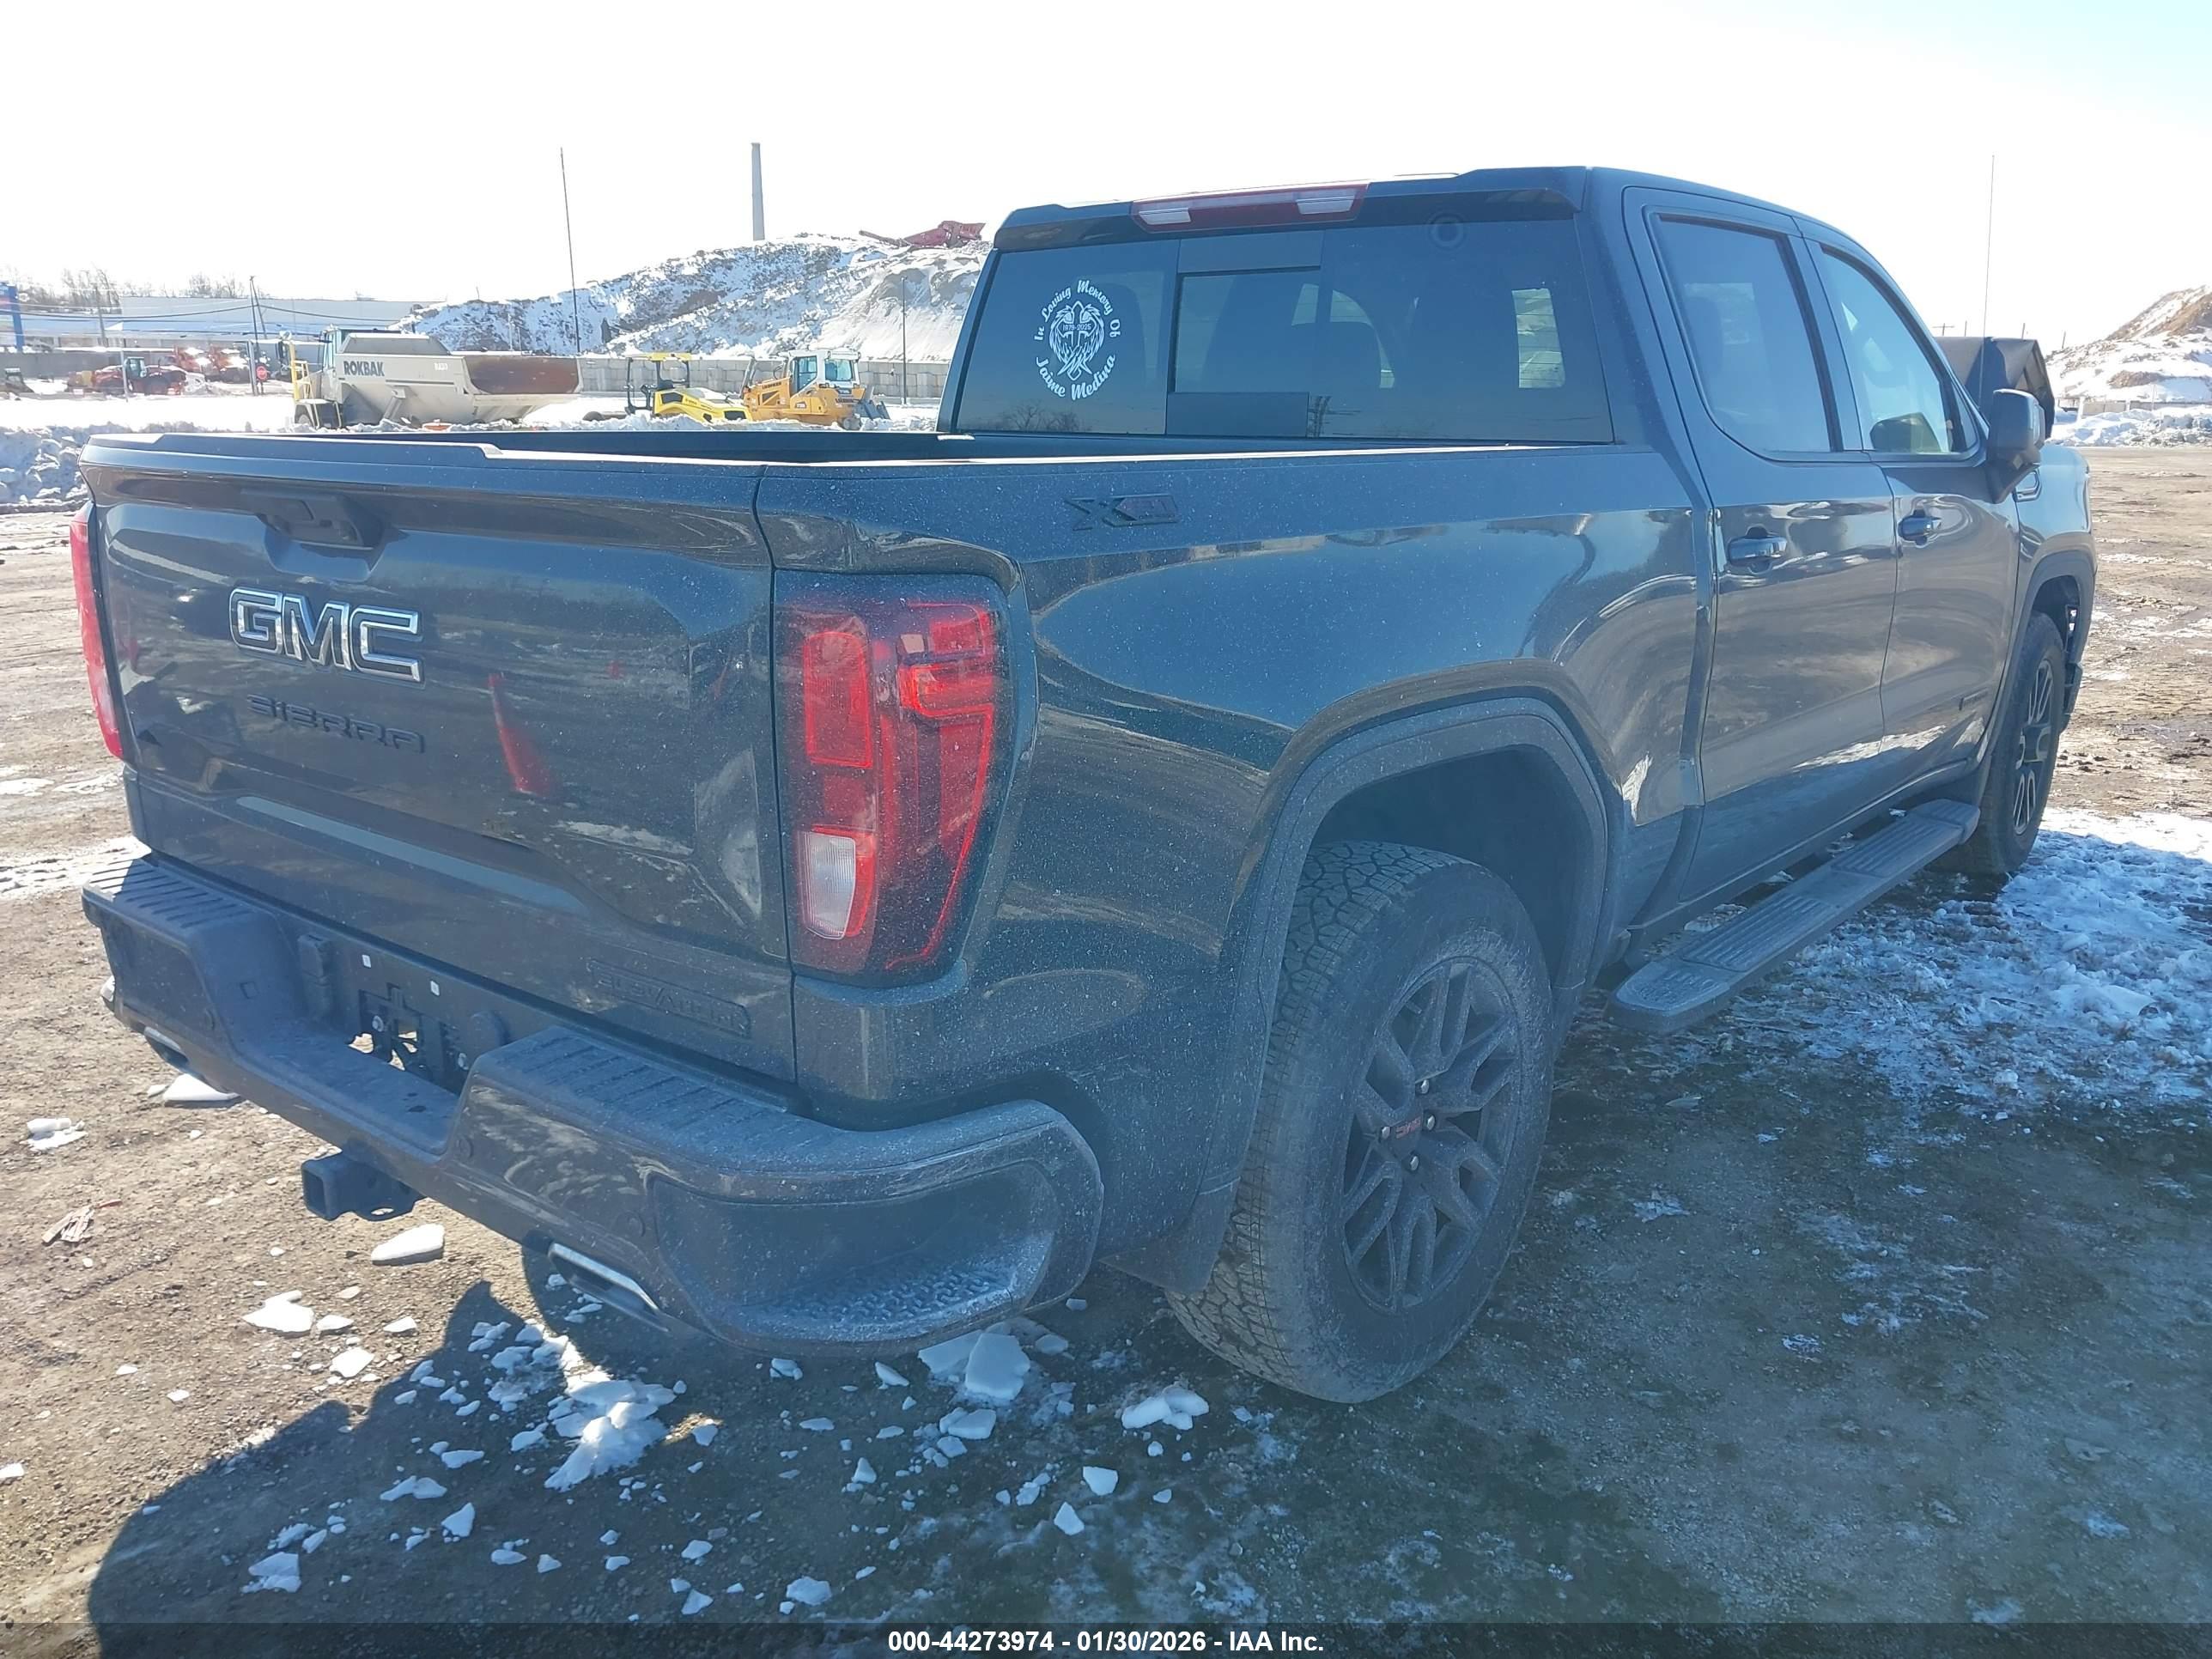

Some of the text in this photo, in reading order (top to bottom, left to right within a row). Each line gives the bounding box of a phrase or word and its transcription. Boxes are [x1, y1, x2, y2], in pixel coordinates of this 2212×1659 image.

[1034, 279, 1121, 341] In Loving Memory Of
[343, 360, 386, 376] ROKBAK
[1036, 354, 1116, 401] Jaime Medina
[228, 586, 423, 685] GMC
[246, 693, 426, 754] SIERRA
